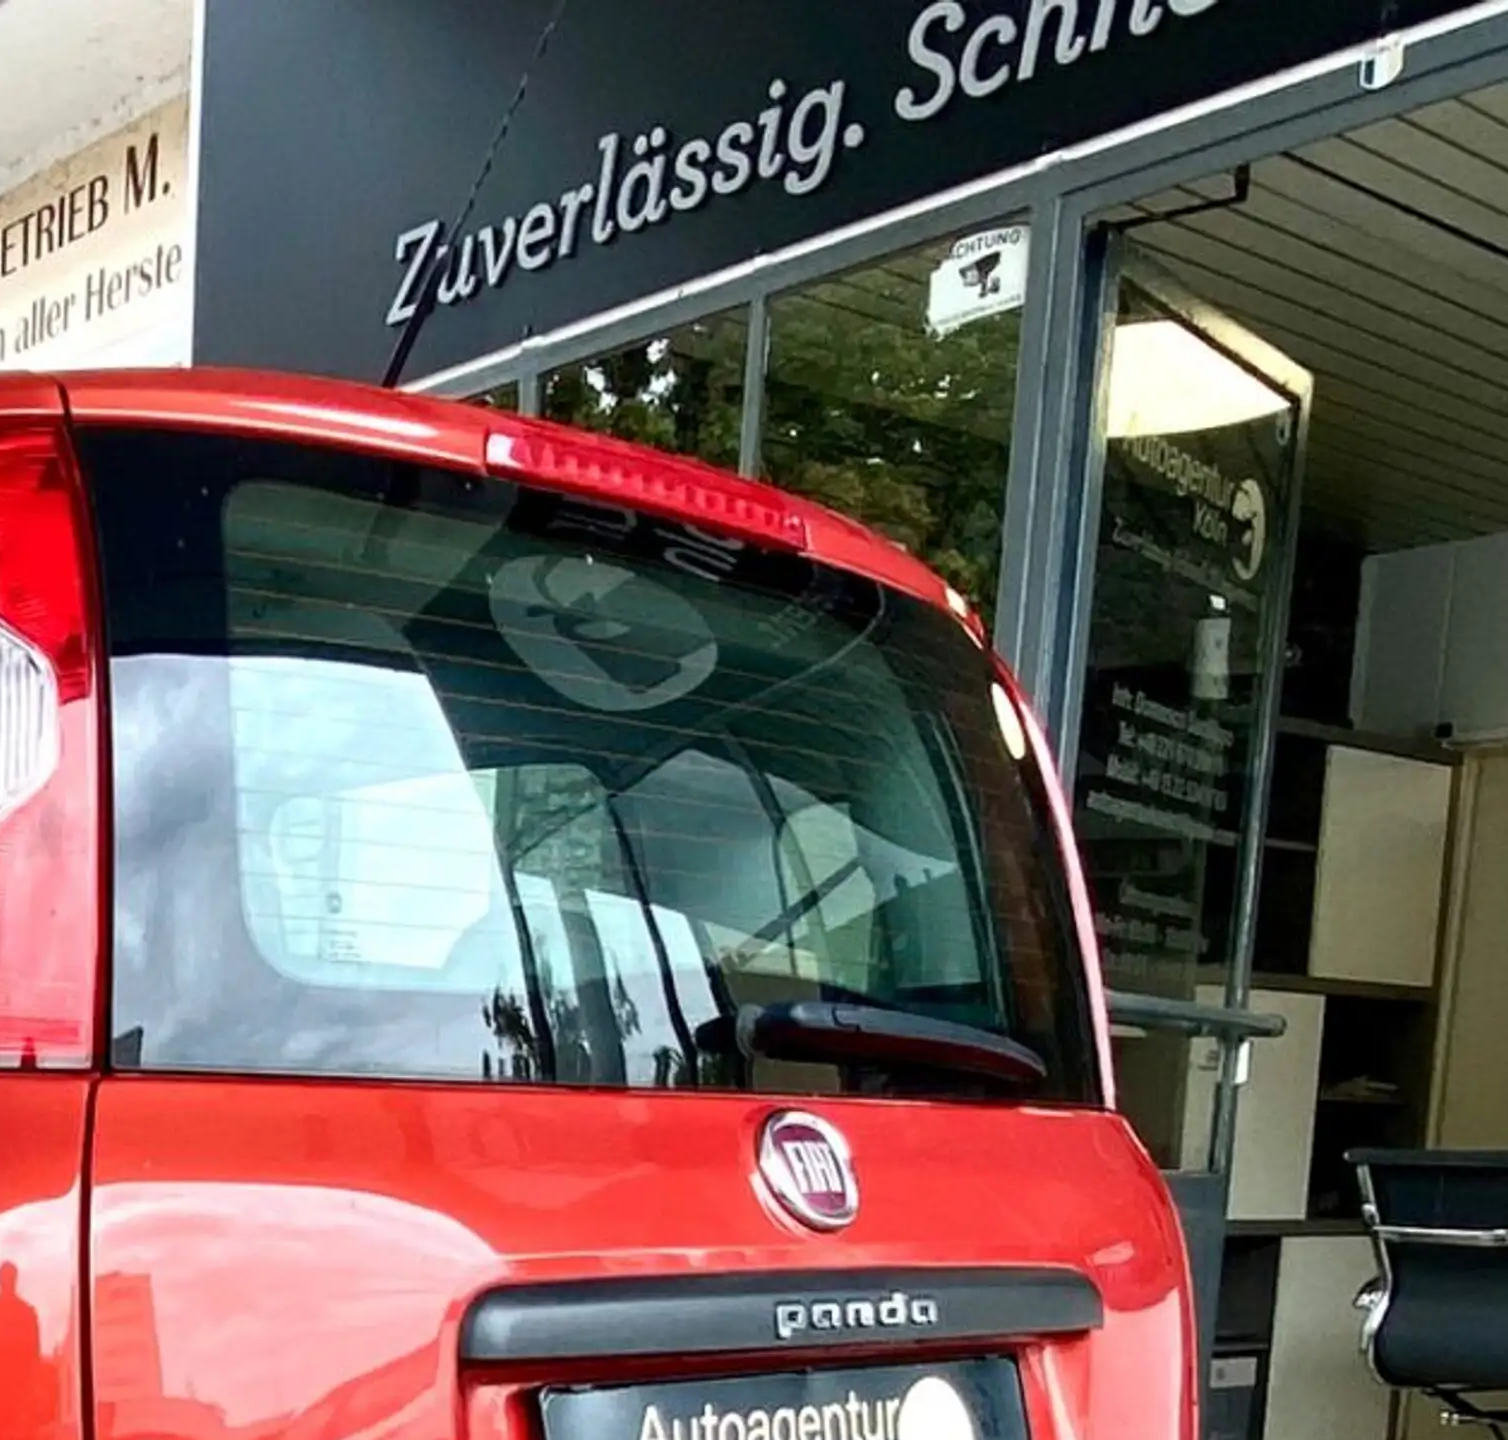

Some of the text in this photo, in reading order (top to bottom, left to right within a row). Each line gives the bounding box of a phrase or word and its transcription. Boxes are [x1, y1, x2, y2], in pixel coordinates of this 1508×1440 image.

[123, 132, 172, 217] M.
[385, 0, 1220, 327] Zuverlässig. Schn
[950, 228, 1023, 260] CHTUNG
[13, 293, 76, 355] aller
[780, 1140, 844, 1195] FIAT
[775, 1291, 940, 1340] panda
